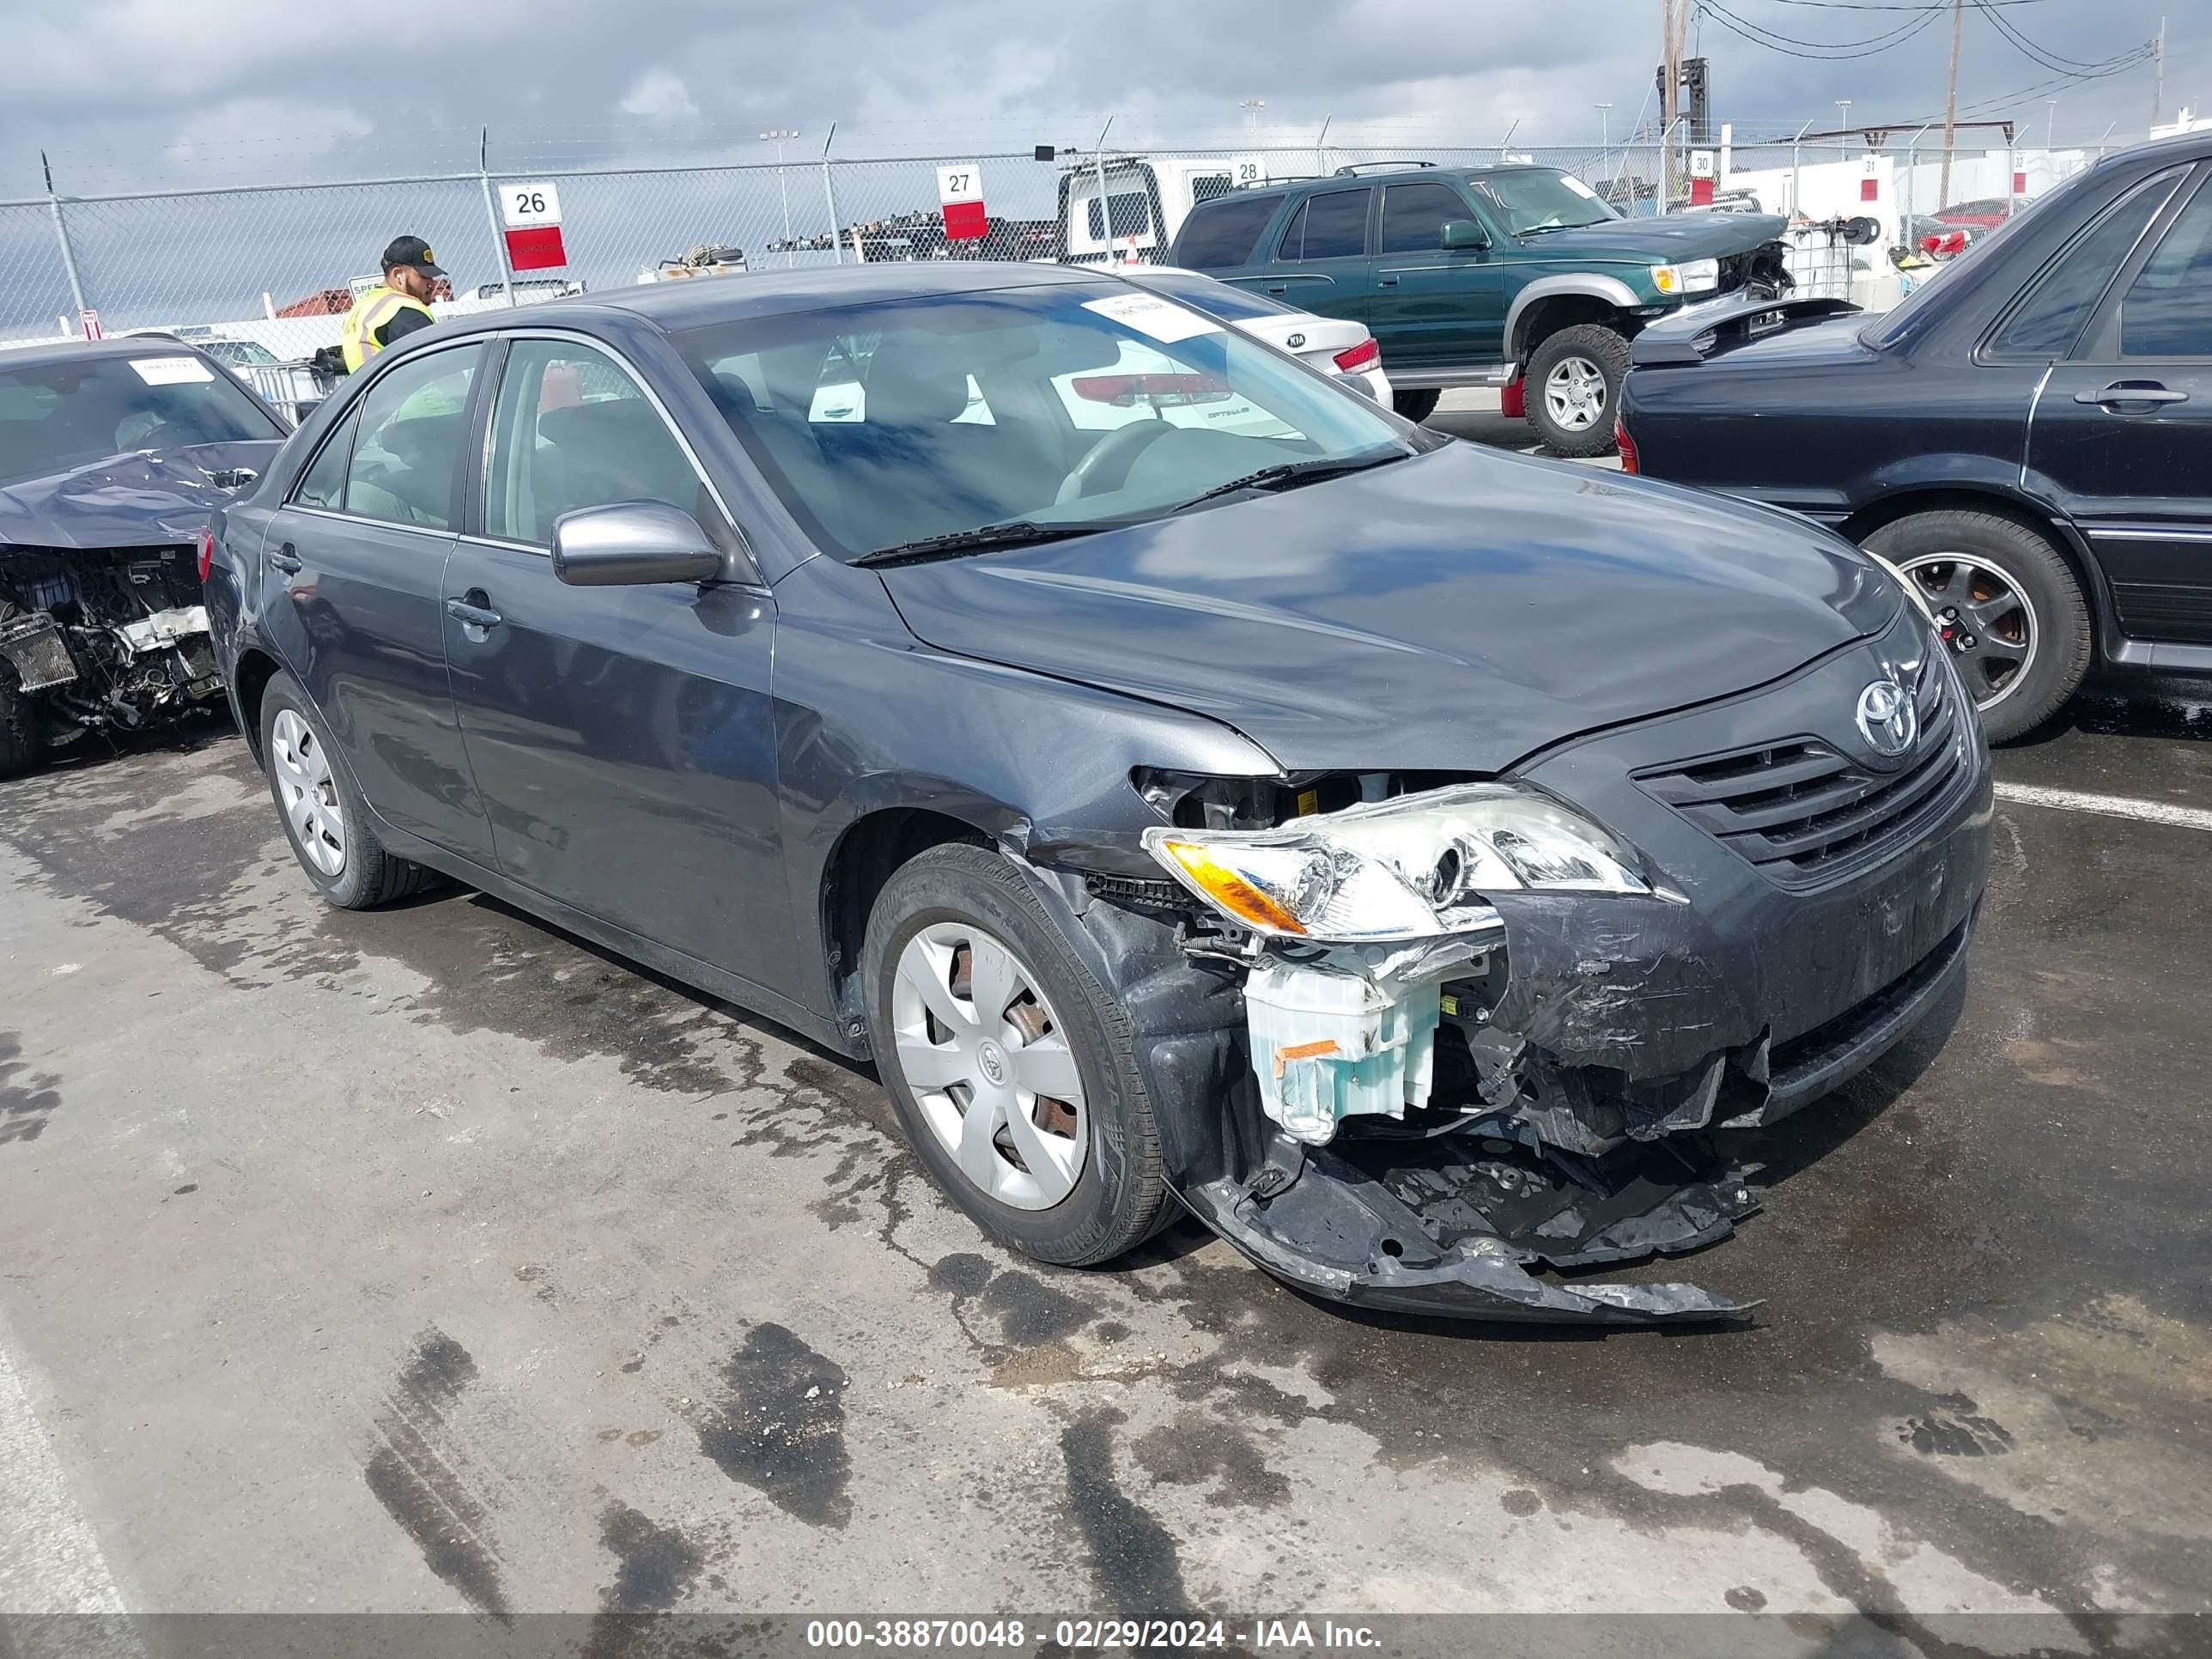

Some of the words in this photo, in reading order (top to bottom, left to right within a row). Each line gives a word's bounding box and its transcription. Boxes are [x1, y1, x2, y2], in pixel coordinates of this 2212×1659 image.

[1697, 157, 1708, 170] 30
[1866, 161, 1875, 172] 31
[1240, 164, 1257, 179] 28
[949, 174, 969, 192] 27
[516, 192, 545, 213] 26
[1289, 334, 1304, 348] KIA
